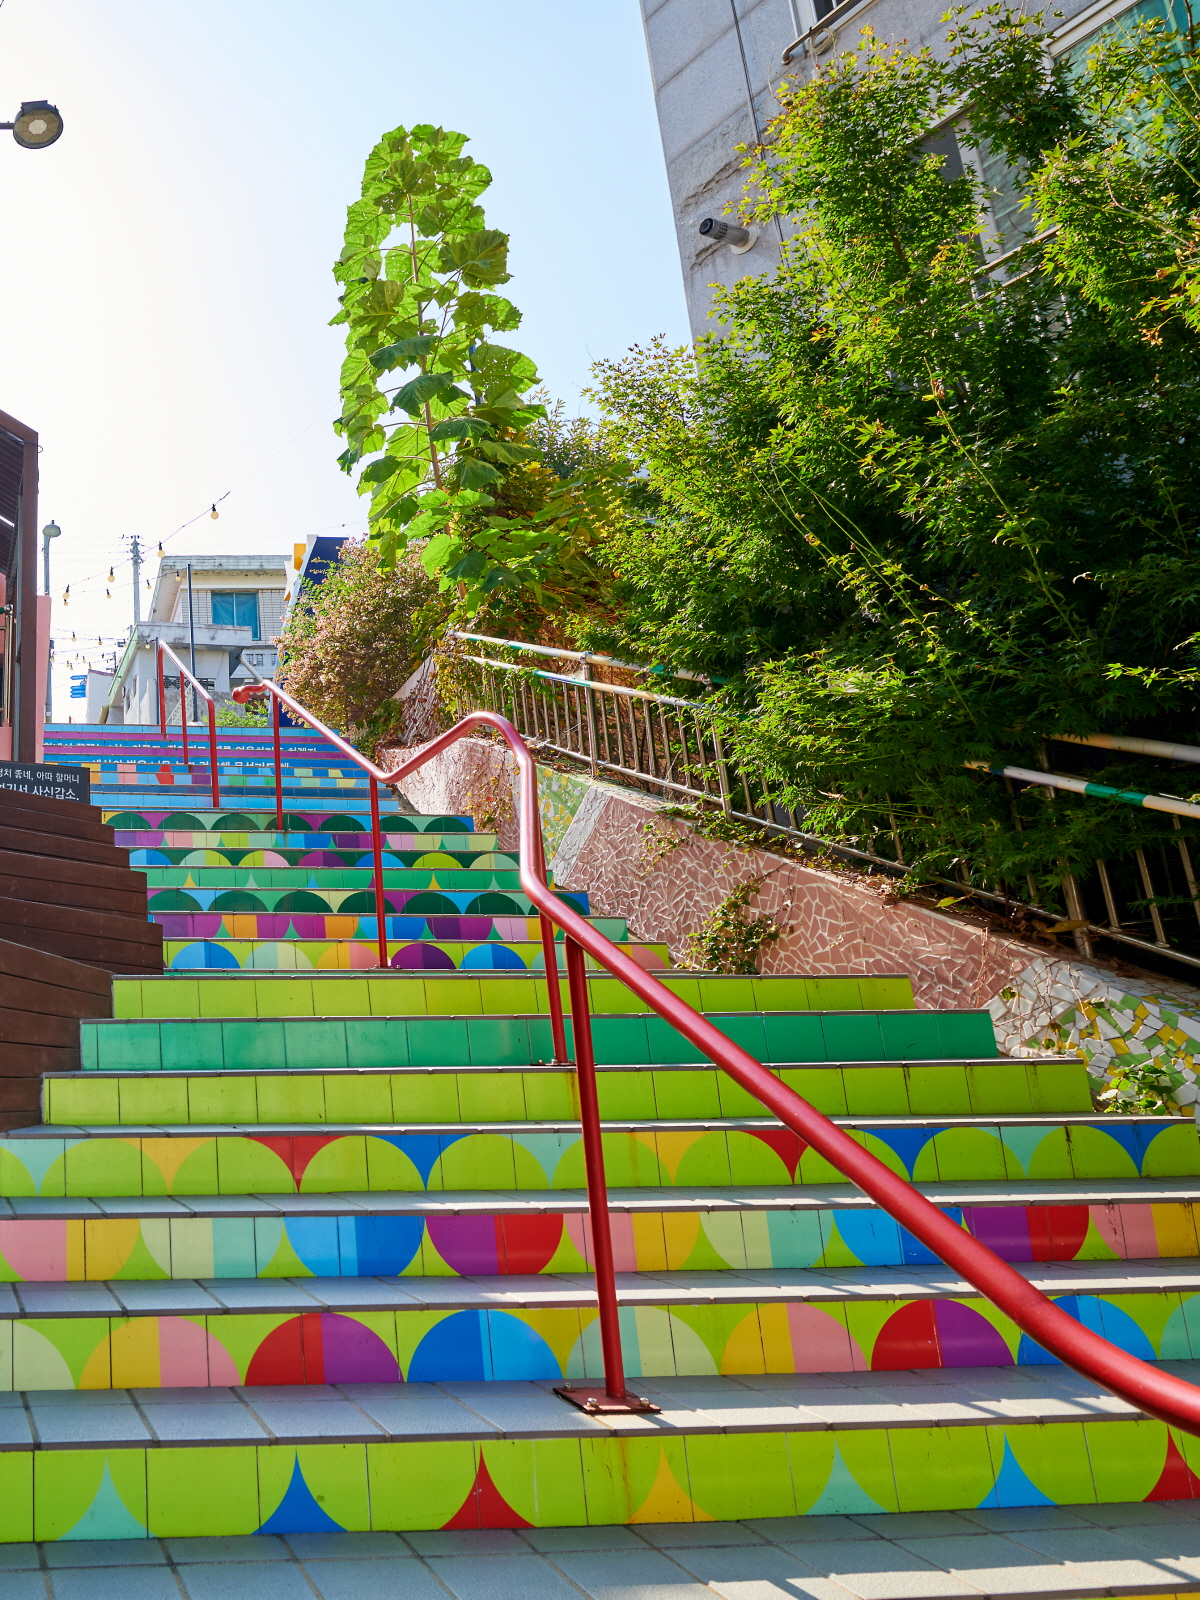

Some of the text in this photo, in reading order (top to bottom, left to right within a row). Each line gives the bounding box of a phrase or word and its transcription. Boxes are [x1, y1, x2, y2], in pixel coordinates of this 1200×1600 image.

[14, 769, 34, 781] 좋네,
[36, 771, 53, 781] 아따
[55, 772, 80, 784] 할머니
